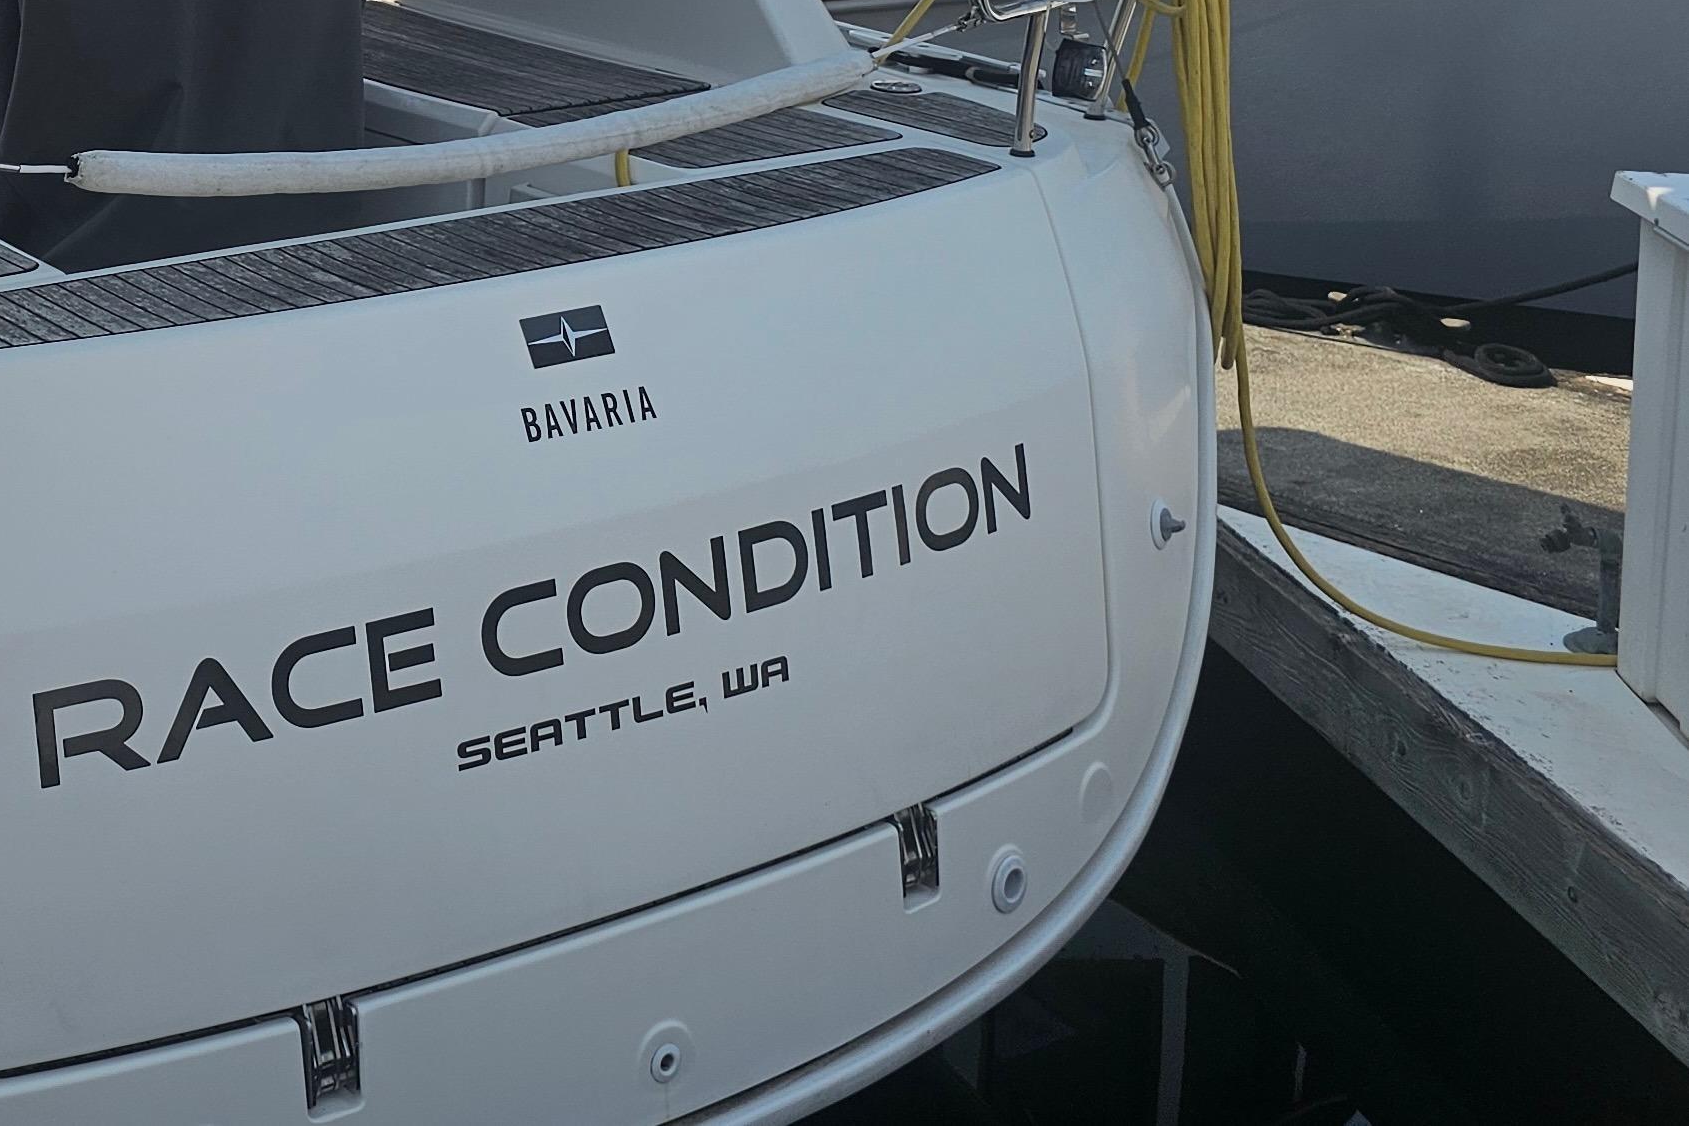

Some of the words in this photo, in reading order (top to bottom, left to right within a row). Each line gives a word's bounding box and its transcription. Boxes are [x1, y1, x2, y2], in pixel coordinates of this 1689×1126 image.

[520, 385, 658, 443] BAVARIA
[32, 607, 443, 789] RACE
[481, 442, 1031, 677] CONDITION
[456, 680, 708, 772] SEATTLE,
[721, 655, 790, 699] WA
